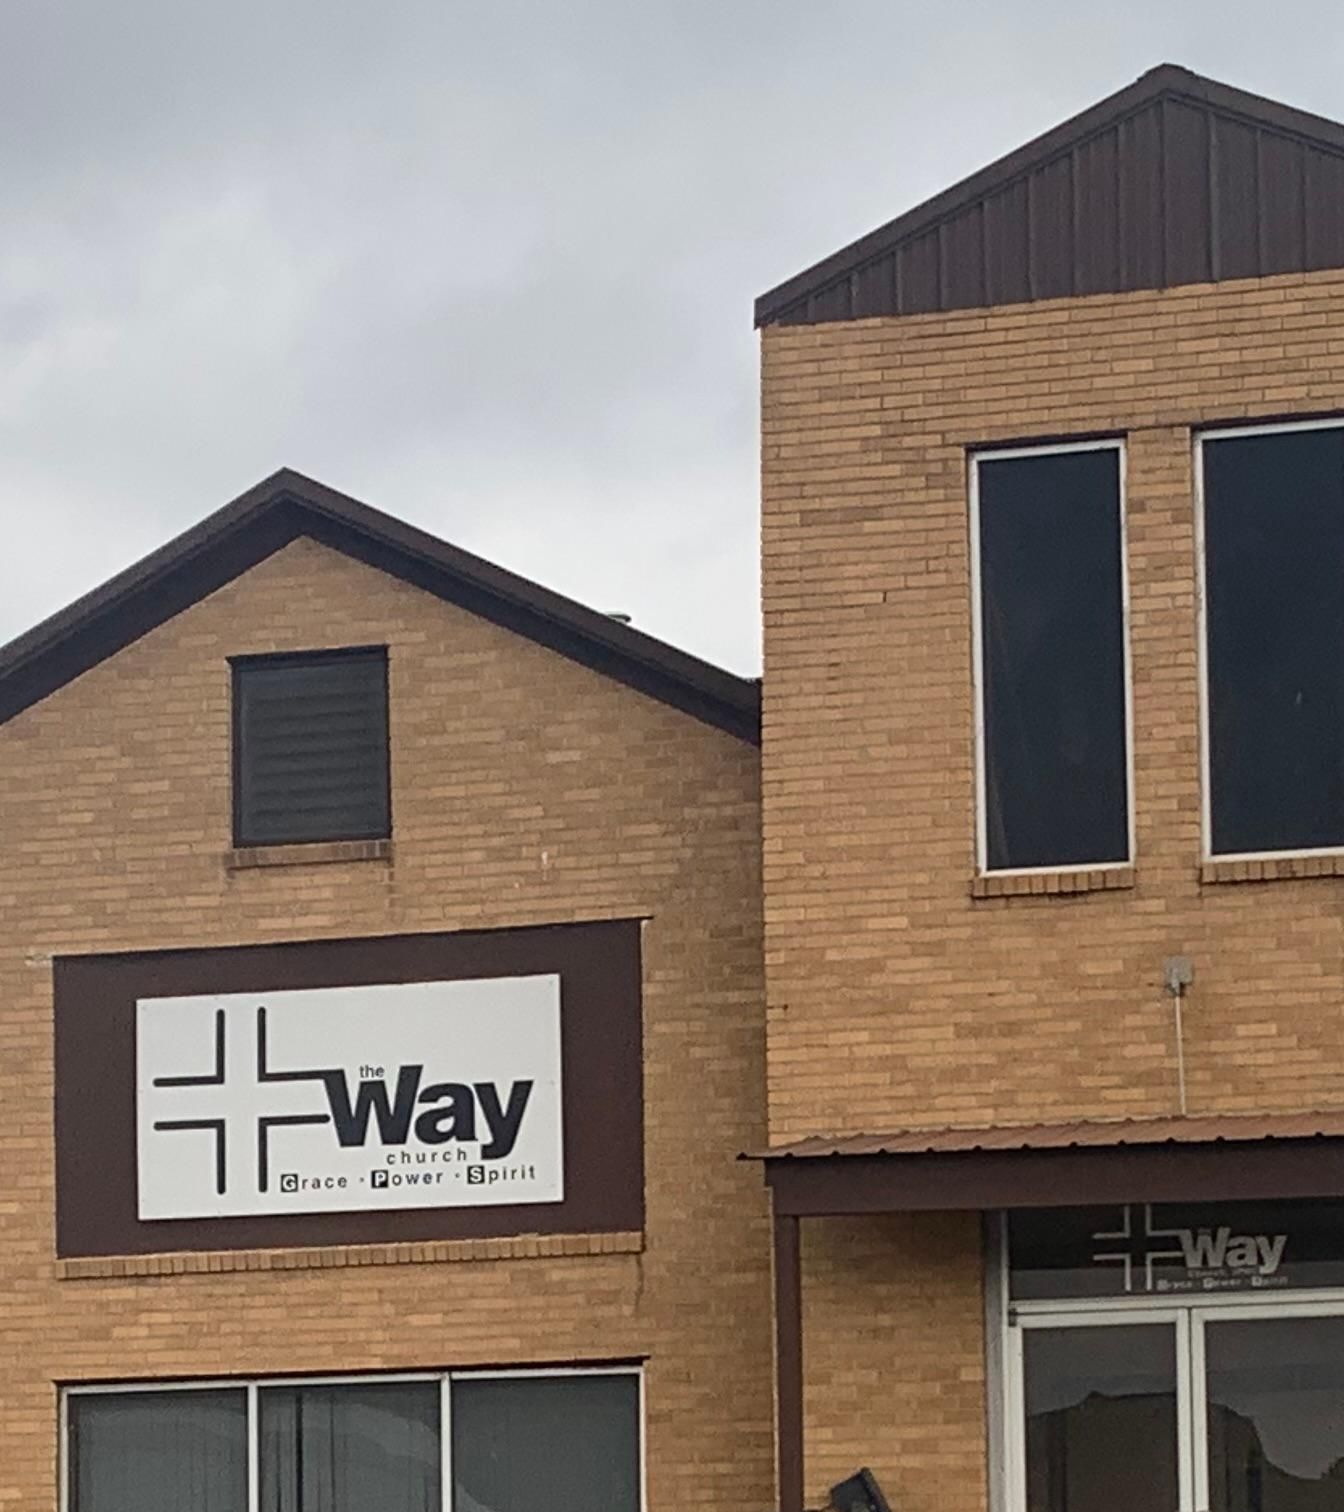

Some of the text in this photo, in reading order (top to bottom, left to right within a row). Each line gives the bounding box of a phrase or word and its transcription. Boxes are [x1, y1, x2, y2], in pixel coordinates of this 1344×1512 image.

[359, 1064, 385, 1079] the
[324, 1064, 534, 1160] Way
[386, 1148, 468, 1165] church
[280, 1164, 536, 1193] Grace Power Spirit
[1178, 1226, 1288, 1275] Way
